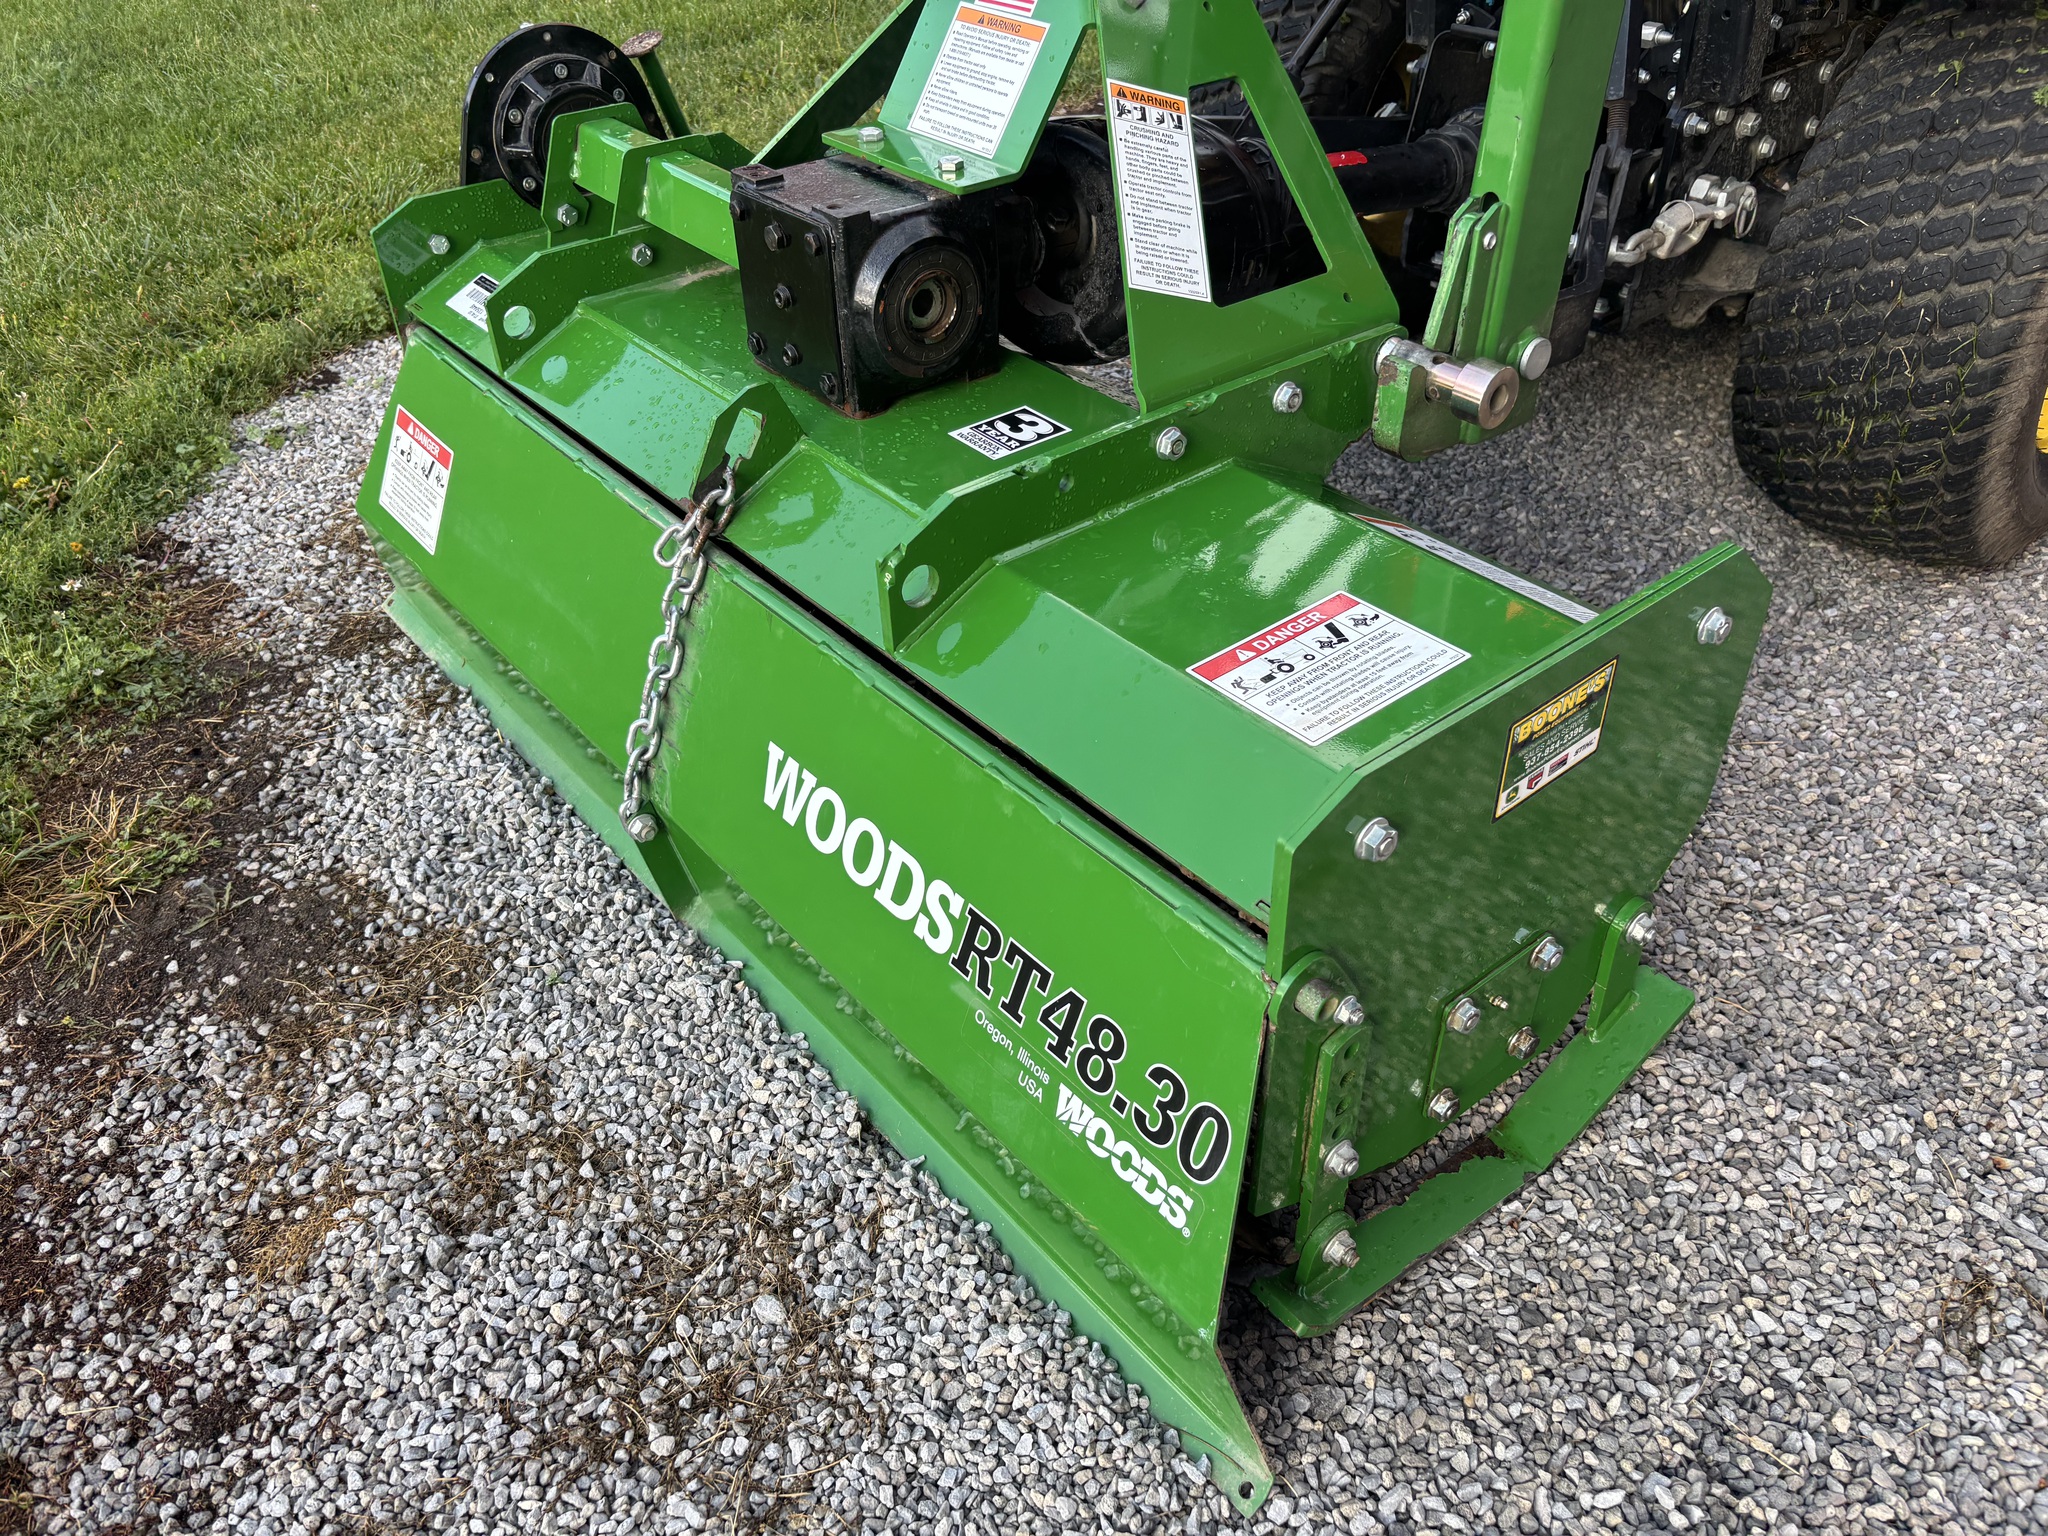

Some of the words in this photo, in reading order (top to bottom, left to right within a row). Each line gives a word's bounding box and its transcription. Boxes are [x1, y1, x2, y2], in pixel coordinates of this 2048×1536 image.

[986, 16, 1022, 34] WARNING
[1130, 91, 1180, 111] WARNING
[1125, 130, 1154, 141] PINCHING
[1154, 137, 1179, 147] HAZARD
[1129, 124, 1160, 136] CRUSHING
[1161, 132, 1174, 140] AND
[1124, 144, 1144, 154] handling
[1144, 149, 1161, 157] various
[1130, 140, 1153, 150] extremely
[1153, 145, 1169, 153] careful
[1138, 164, 1150, 172] body
[1145, 154, 1157, 162] They
[1165, 159, 1179, 167] heavy
[1126, 167, 1145, 176] crushed
[1151, 173, 1170, 181] pinched
[1170, 177, 1189, 185] between
[1127, 172, 1143, 180] tractor
[1128, 180, 1146, 188] Operate
[1162, 188, 1181, 196] controls
[1139, 201, 1163, 210] implement
[1158, 199, 1177, 207] between
[1132, 219, 1152, 227] engaged
[1152, 222, 1167, 230] before
[1167, 226, 1181, 234] going
[1155, 218, 1173, 226] parking
[1133, 257, 1154, 266] FAILURE
[1162, 263, 1183, 271] FOLLOW
[1183, 267, 1199, 275] THESE
[1135, 269, 1154, 278] RESULT
[1161, 274, 1182, 283] SERIOUS
[1140, 265, 1176, 276] INSTRUCTIONS
[1176, 271, 1194, 279] COULD
[978, 424, 1020, 448] YEAR
[994, 413, 1055, 442] 3
[414, 427, 440, 457] DANGER
[957, 432, 999, 455] WARRANTY
[966, 431, 1002, 452] GEARBOX
[1252, 611, 1327, 650] DANGER
[1265, 684, 1286, 698] KEEP
[1287, 673, 1308, 687] AWAY
[1306, 662, 1330, 676] FROM
[1328, 648, 1354, 664] FRONT
[1353, 640, 1370, 651] AND
[1368, 629, 1390, 642] REAR
[1266, 684, 1305, 706] OPENINGS
[1303, 671, 1328, 686] WHEN
[1325, 653, 1362, 673] TRACTOR
[1367, 632, 1403, 651] RUNNING.
[1290, 690, 1313, 704] Objects
[1311, 684, 1323, 692] can
[1329, 670, 1350, 682] thrown
[1355, 655, 1378, 668] rotating
[1374, 646, 1396, 657] blades.
[1297, 694, 1321, 708] Contact
[1319, 688, 1333, 696] with
[1331, 676, 1354, 690] rotating
[1351, 667, 1371, 678] blades
[1379, 653, 1396, 663] cause
[1393, 644, 1412, 655] injury.
[1304, 702, 1322, 712] Keep
[1319, 686, 1351, 704] bystanders
[1354, 675, 1370, 685] least
[1375, 665, 1388, 673] feet
[1386, 658, 1402, 668] away
[1399, 651, 1414, 660] from
[1302, 715, 1331, 732] FAILURE
[1328, 709, 1340, 717] TO
[1338, 695, 1366, 712] FOLLOW
[1363, 683, 1386, 697] THESE
[1384, 660, 1428, 686] INSTRUCTIONS
[1426, 649, 1448, 662] COULD
[1311, 697, 1341, 716] equipment
[1339, 688, 1360, 700] during
[1357, 674, 1385, 690] operation.
[1326, 710, 1352, 726] RESULT
[1358, 691, 1387, 708] SERIOUS
[1384, 679, 1407, 693] INJURY
[1406, 673, 1418, 681] OR
[1415, 662, 1439, 676] DEATH.
[1518, 671, 1608, 743] BOONE'S
[1522, 741, 1545, 763] SALES
[1545, 731, 1560, 747] AND
[1560, 711, 1589, 737] SERVICE
[763, 741, 964, 955] WOODS
[949, 902, 1232, 1185] RT48.30
[974, 1009, 1014, 1054] Oregon,
[1016, 1046, 1050, 1084] Illinois
[1017, 1070, 1044, 1103] USA
